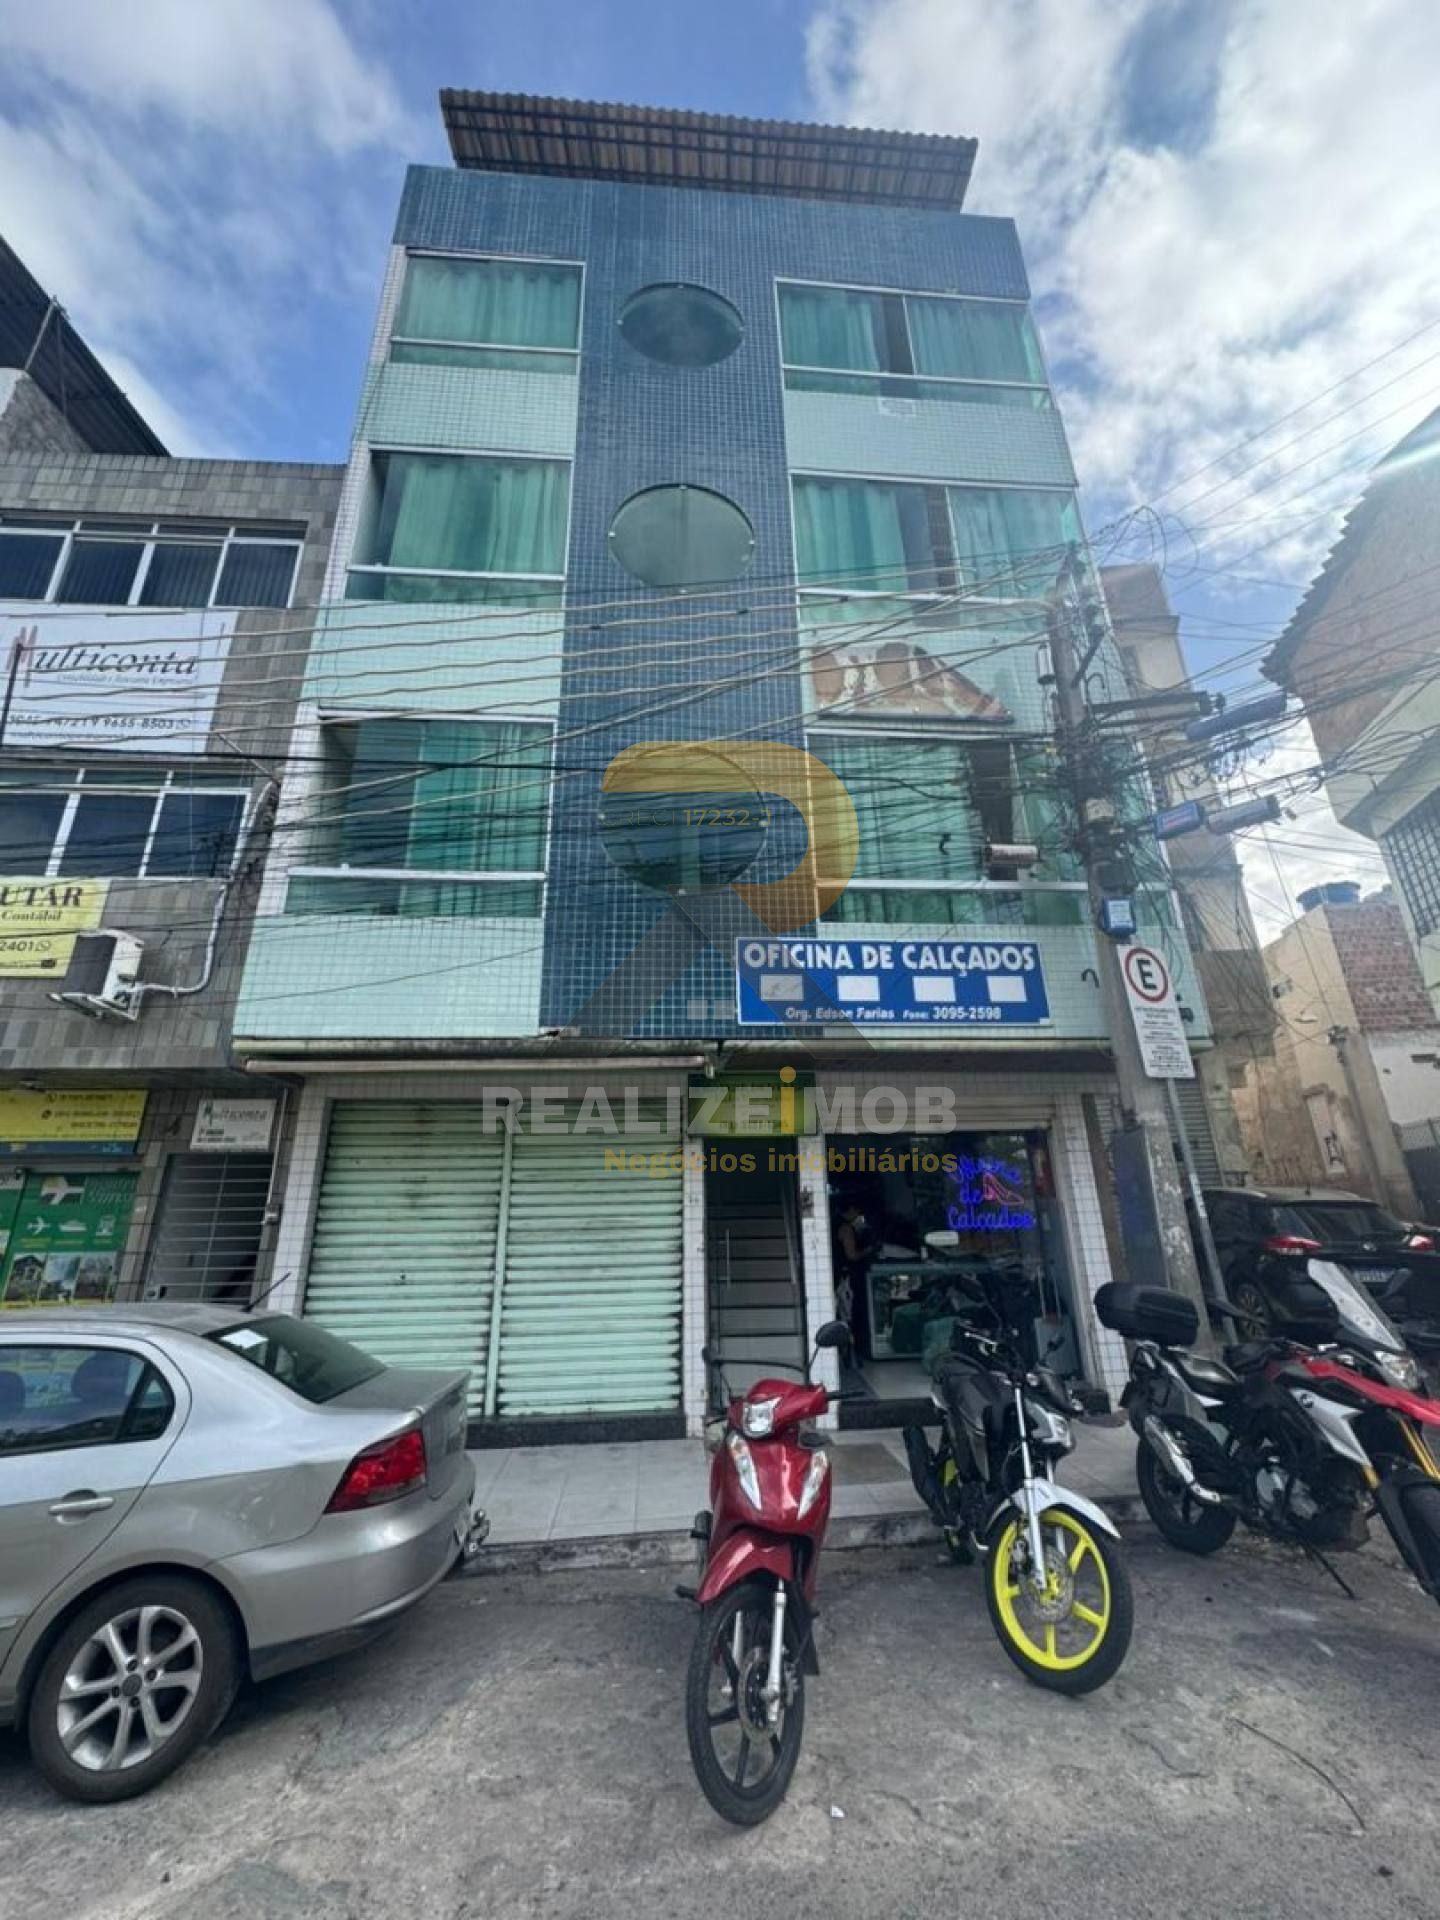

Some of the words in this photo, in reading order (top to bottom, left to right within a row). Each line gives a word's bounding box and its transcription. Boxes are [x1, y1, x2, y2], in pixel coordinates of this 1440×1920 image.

[744, 943, 854, 970] OFICINA
[861, 945, 894, 969] DE
[902, 945, 1035, 977] CALÇADOS
[1136, 959, 1157, 990] E
[856, 1007, 895, 1020] Farias
[932, 1006, 1001, 1020] 3095-2598
